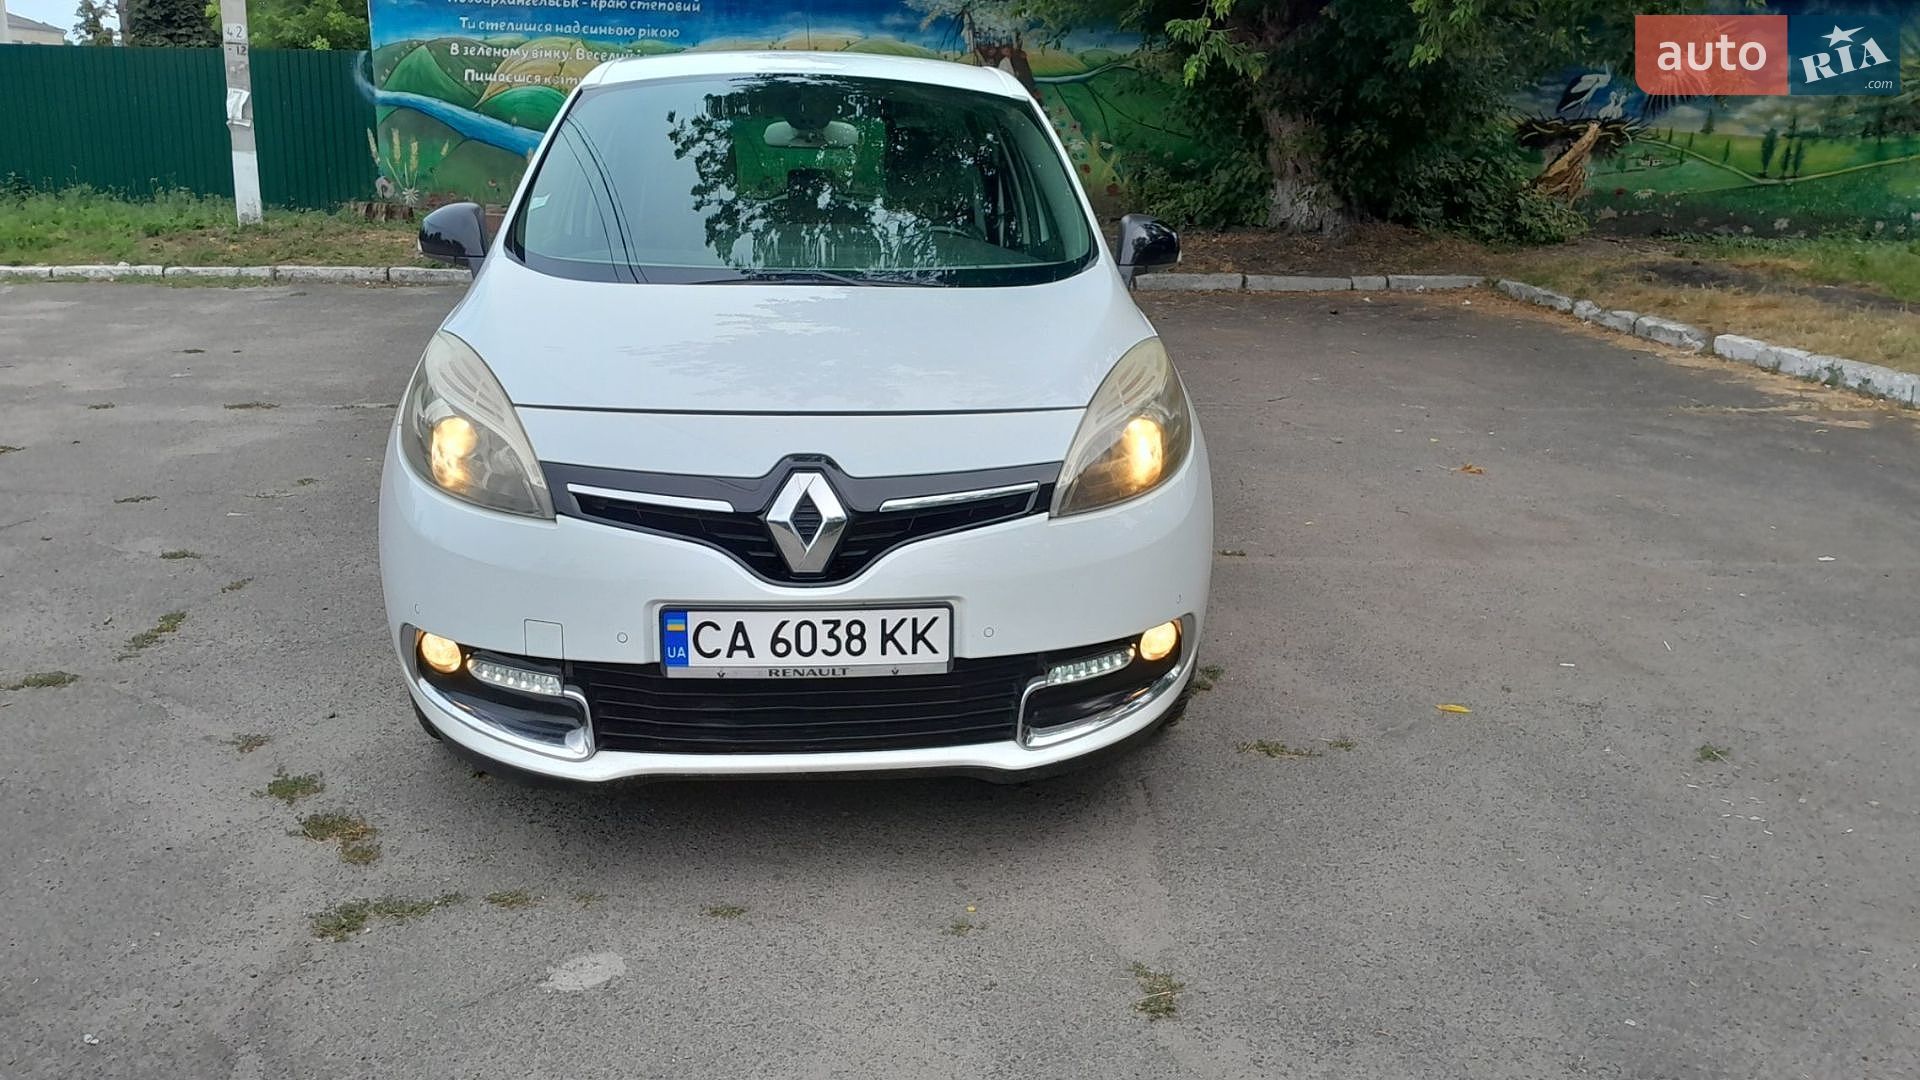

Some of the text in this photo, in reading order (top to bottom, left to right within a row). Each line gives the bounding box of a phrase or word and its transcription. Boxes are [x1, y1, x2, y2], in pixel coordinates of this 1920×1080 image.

[590, 0, 627, 11] краю
[630, 0, 701, 12] степовий
[459, 16, 680, 39] Ти стелишся над синьою рікою
[450, 42, 460, 56] В
[463, 46, 529, 60] зеленому
[544, 72, 582, 86] квіт
[692, 616, 940, 658] CA 6038 KK
[667, 646, 686, 658] UA
[768, 667, 850, 678] RENAULT
